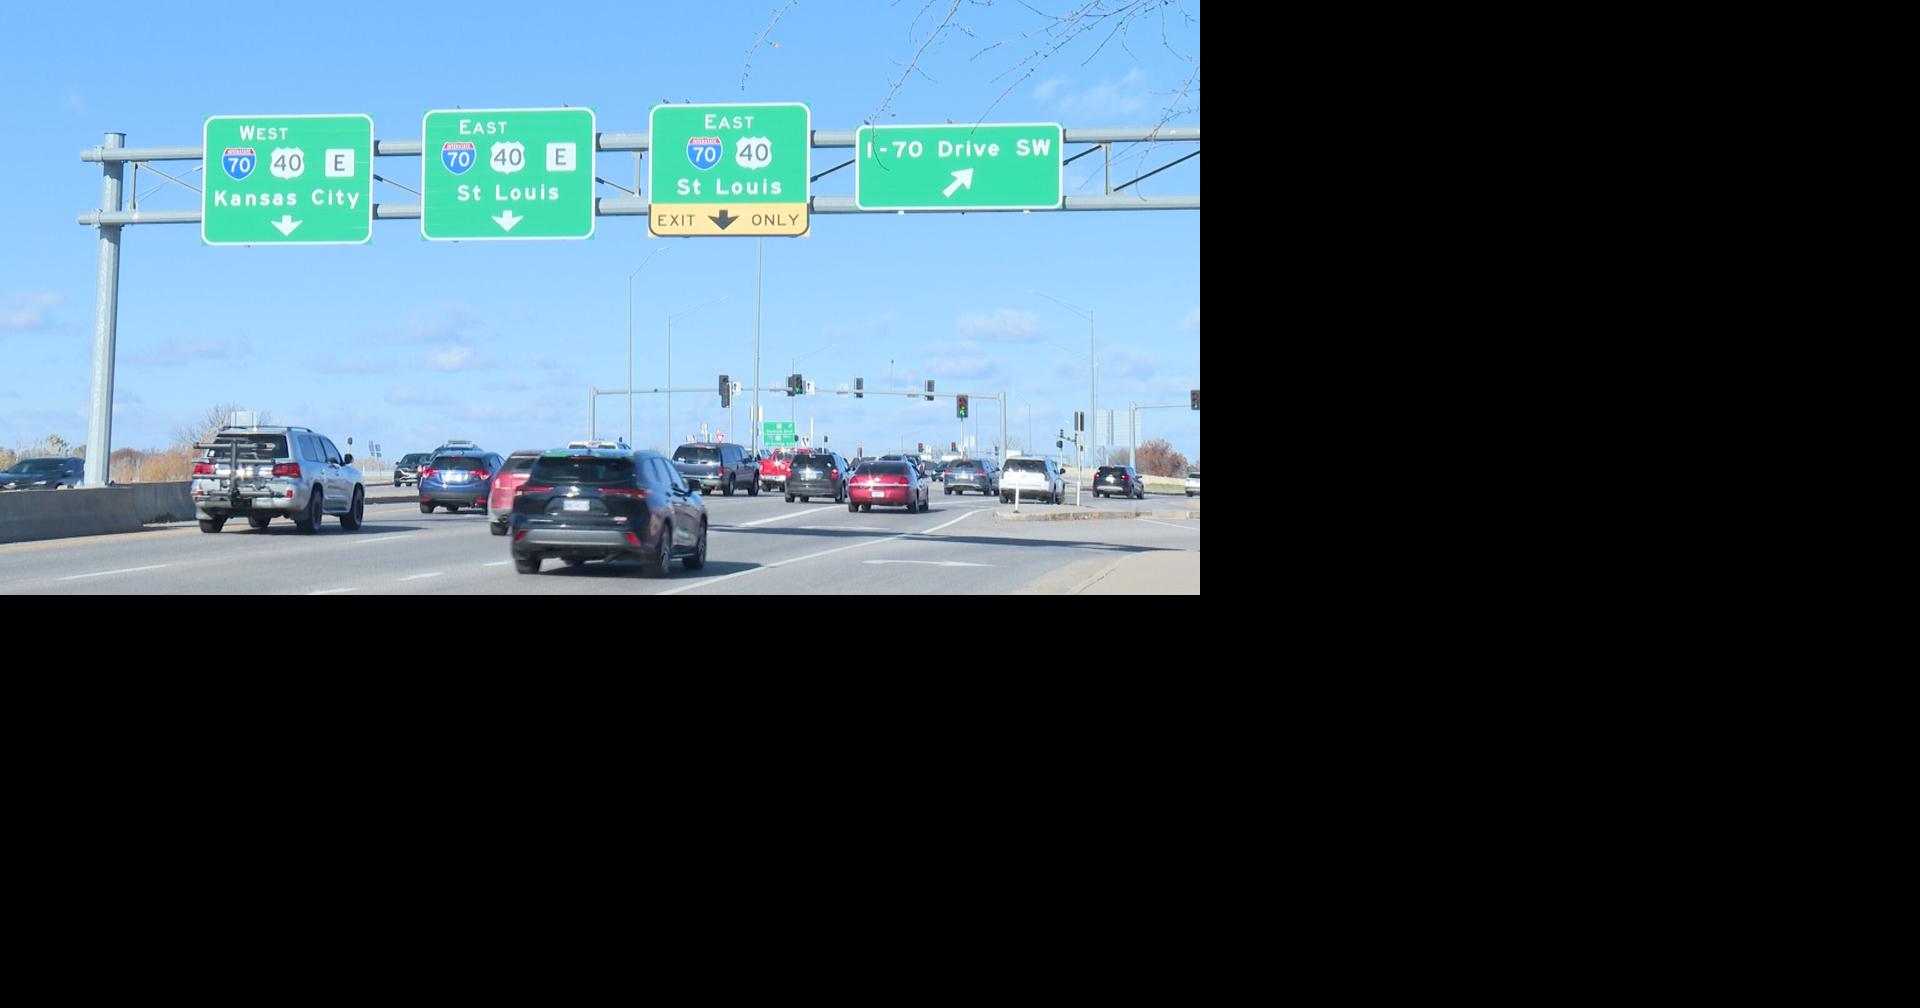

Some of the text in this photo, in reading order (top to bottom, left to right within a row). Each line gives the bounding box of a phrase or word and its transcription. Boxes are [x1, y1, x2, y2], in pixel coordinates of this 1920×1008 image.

[459, 119, 507, 134] EAST
[704, 113, 754, 129] EAST
[239, 125, 288, 141] WEST
[693, 146, 717, 163] 70
[739, 143, 769, 161] 40
[938, 140, 1000, 158] Drive
[1016, 138, 1051, 156] SW
[227, 157, 251, 173] 70
[273, 153, 302, 172] 40
[334, 154, 345, 172] E
[448, 151, 470, 167] 70
[494, 148, 522, 166] 40
[555, 148, 567, 166] E
[457, 184, 559, 201] St Louis
[676, 178, 783, 195] St Louis
[214, 189, 360, 209] Kansas City
[657, 213, 800, 227] EXIT ONLY
